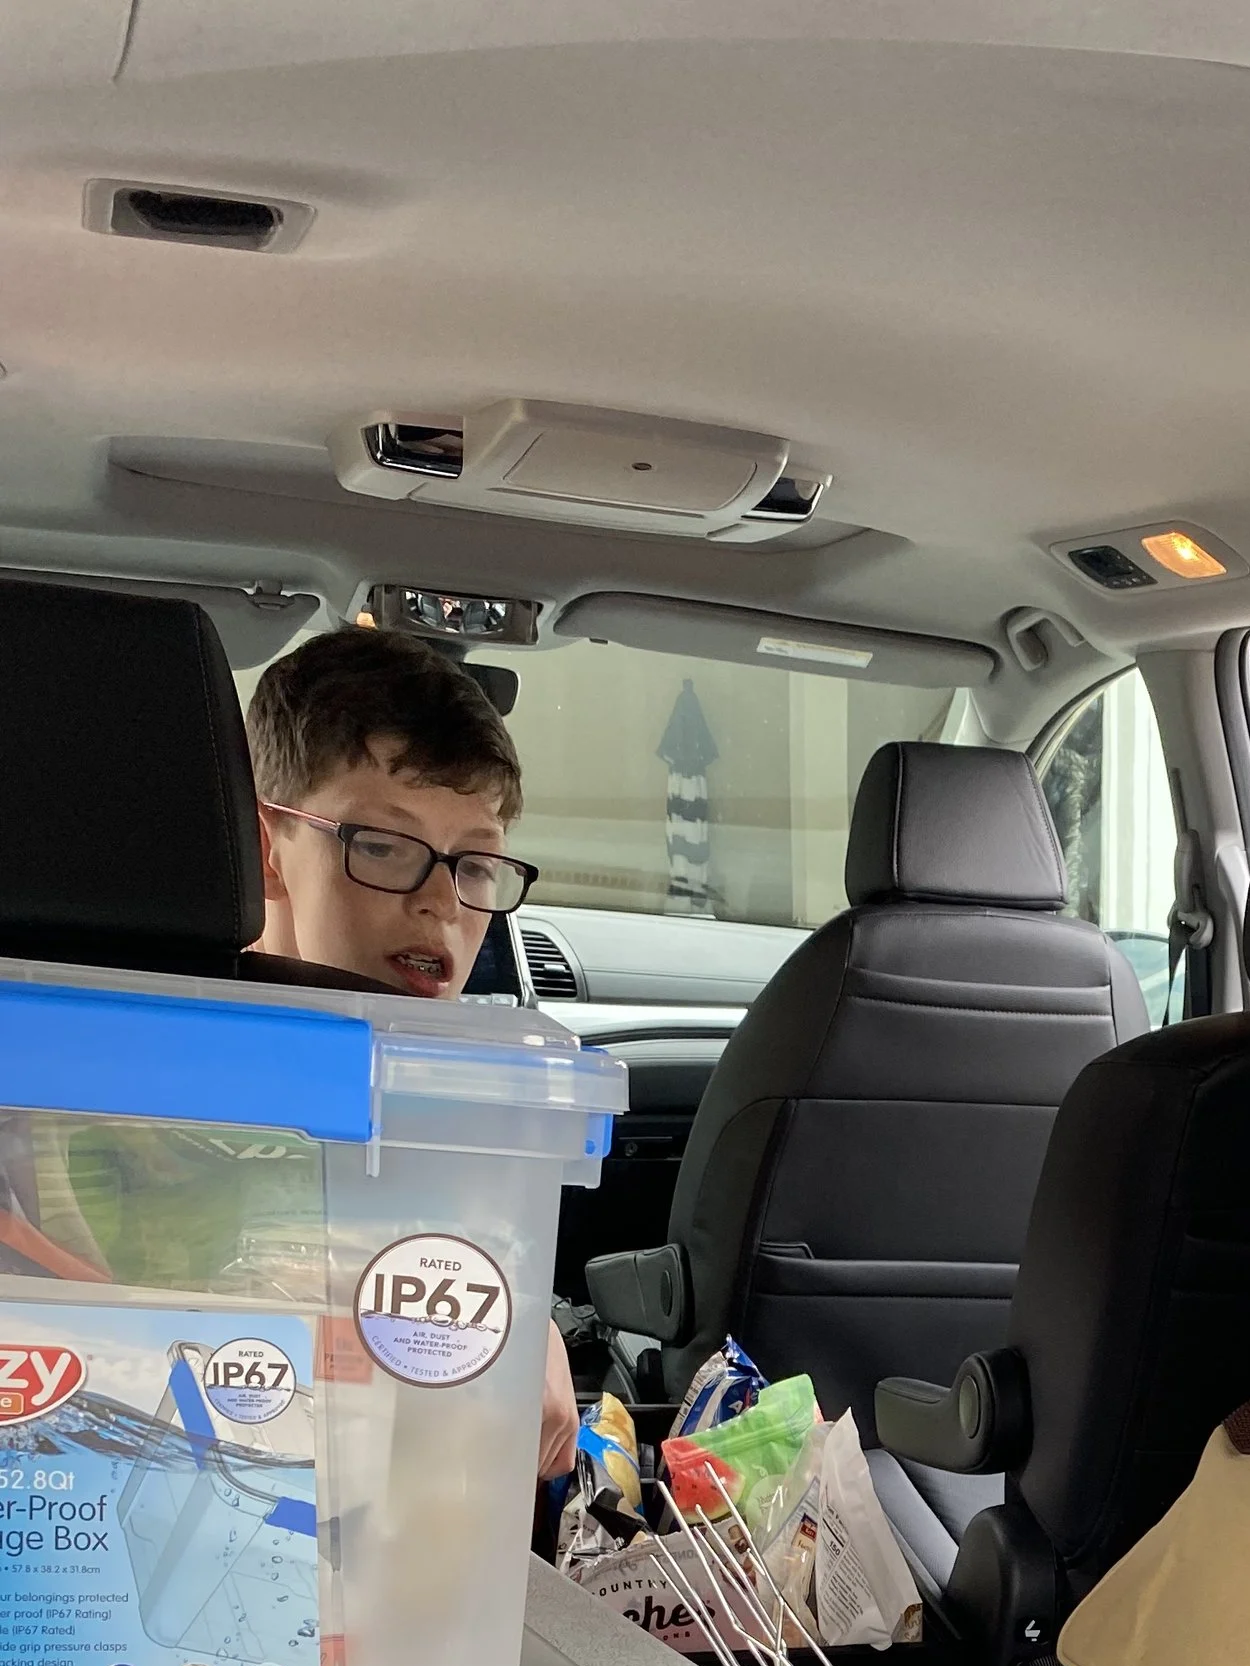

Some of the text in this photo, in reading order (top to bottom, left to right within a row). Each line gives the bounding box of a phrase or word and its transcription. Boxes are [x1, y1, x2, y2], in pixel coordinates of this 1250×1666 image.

[420, 1258, 461, 1271] RATED
[374, 1274, 500, 1323] IP67
[431, 1332, 450, 1341] DUST
[393, 1337, 468, 1351] AND WATER-PROOF
[239, 1350, 263, 1358] RATED
[372, 1336, 402, 1366] CERTIFIED
[411, 1366, 439, 1377] TESTED
[452, 1348, 490, 1375] APPROVED
[407, 1347, 452, 1358] PROTECTED
[213, 1361, 288, 1388] IP67
[0, 1494, 107, 1522] r-Proof
[55, 1525, 108, 1551] Box
[41, 1565, 59, 1574] 38.2
[592, 1579, 668, 1597] OUNTRY
[15, 1592, 129, 1604] belongings protected
[14, 1608, 112, 1621] proof (IP67 Rating)
[12, 1625, 76, 1636] (IP67 Rated)
[20, 1642, 41, 1655] grip
[44, 1644, 91, 1656] pressure
[93, 1642, 127, 1655] clasps
